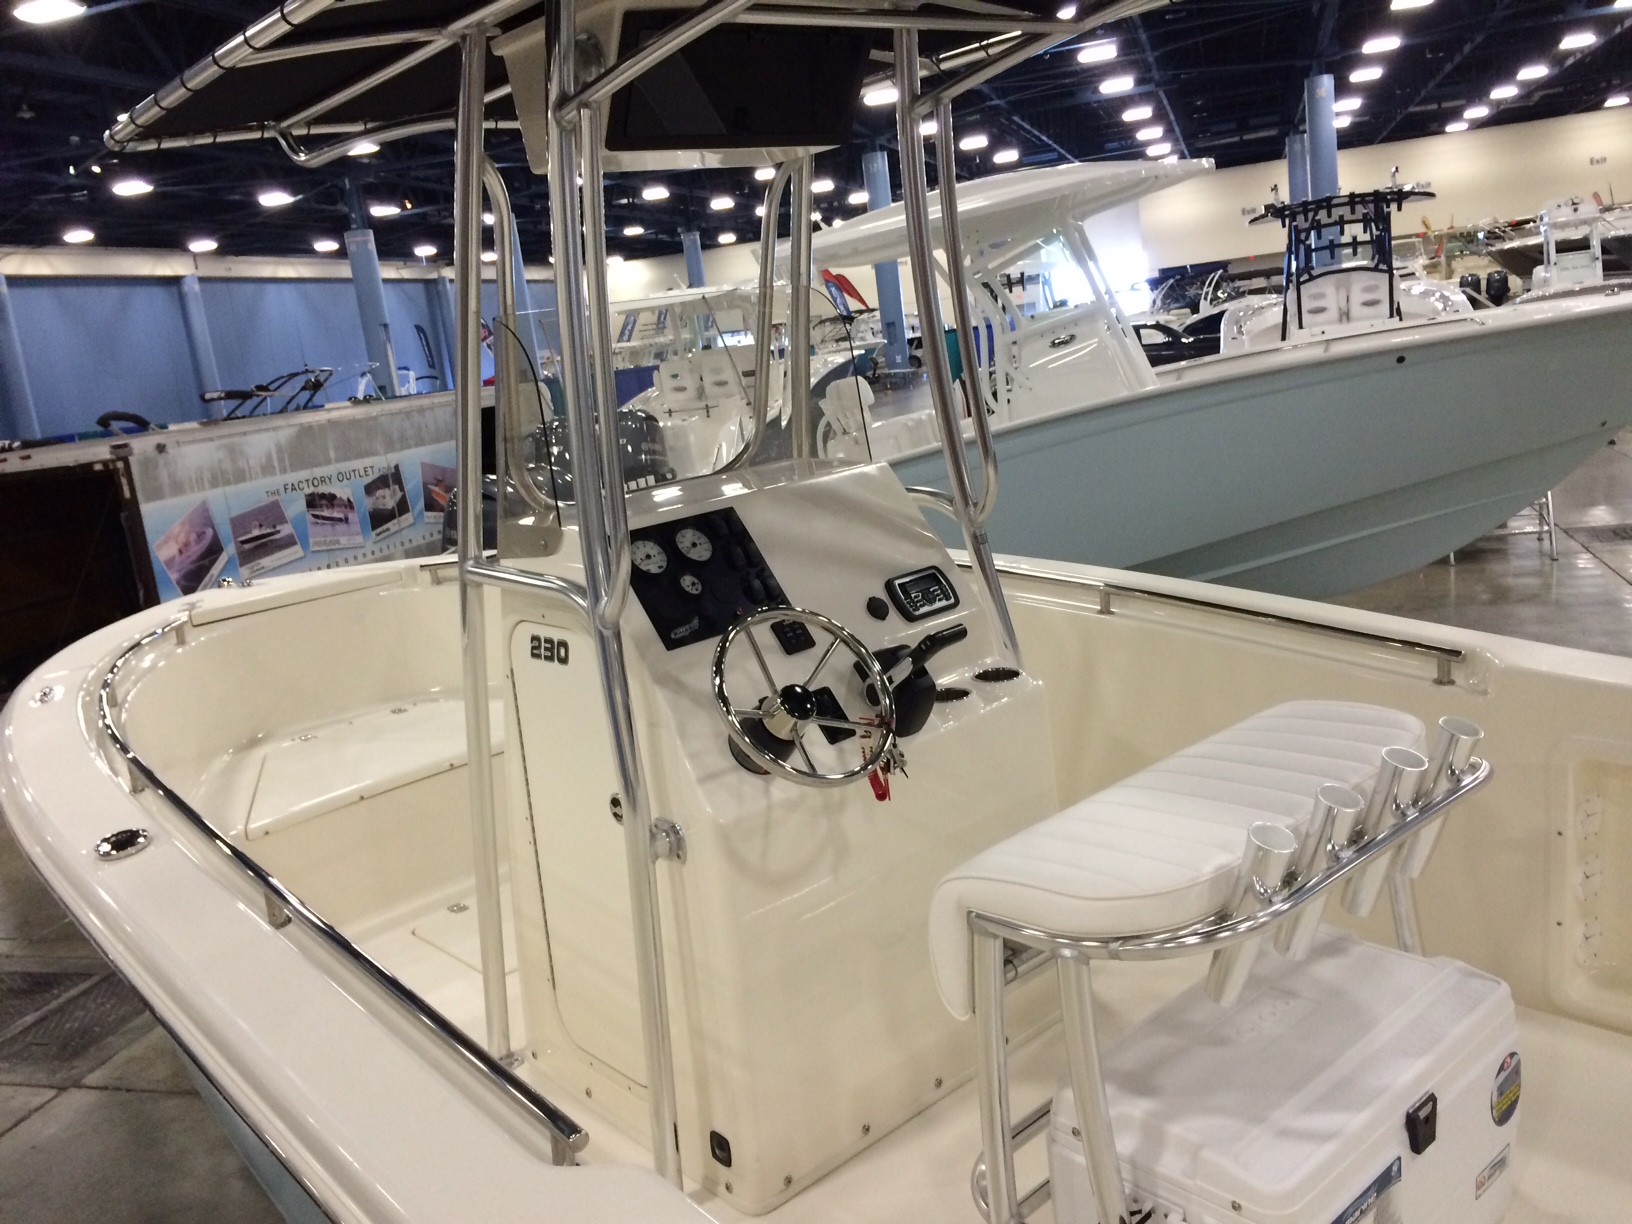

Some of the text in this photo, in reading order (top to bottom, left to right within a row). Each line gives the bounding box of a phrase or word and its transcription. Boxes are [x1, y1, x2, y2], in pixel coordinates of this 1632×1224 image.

[265, 488, 281, 498] THE
[283, 474, 333, 494] FACTORY
[336, 465, 375, 483] OUTLET
[530, 633, 570, 666] 230
